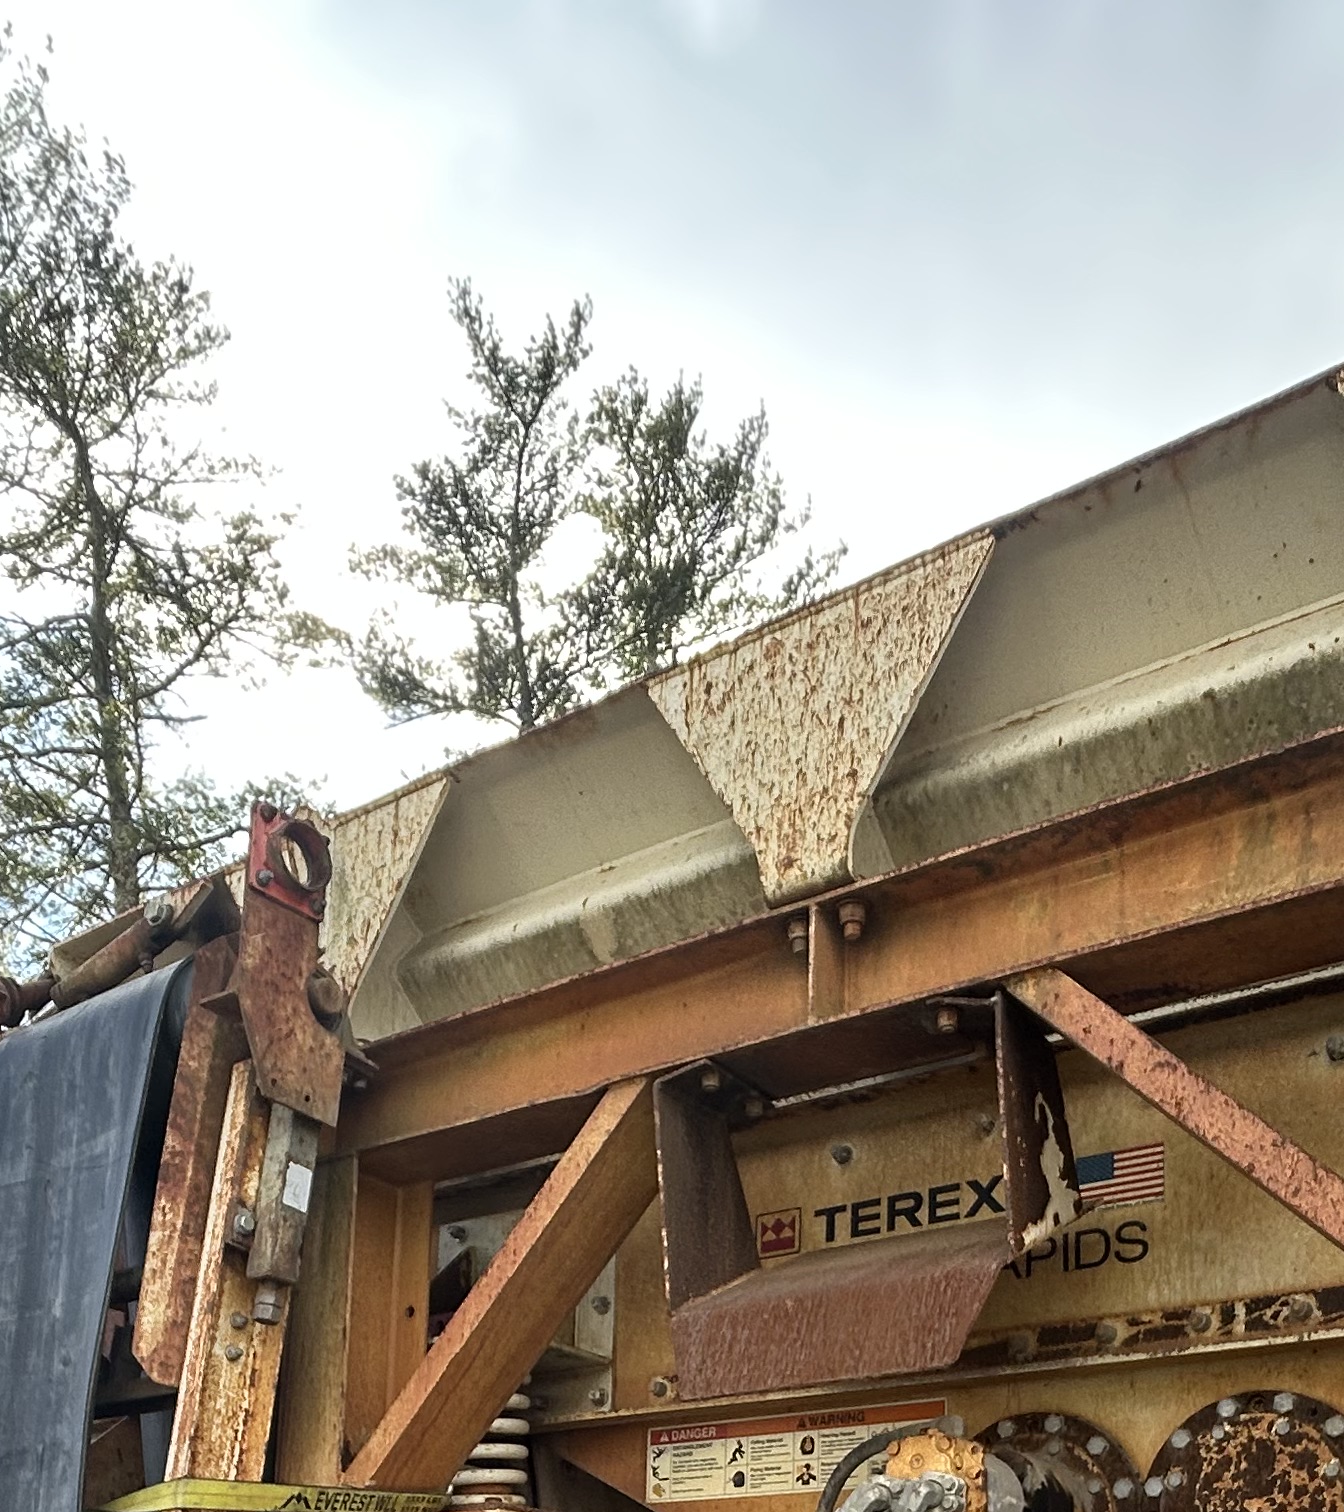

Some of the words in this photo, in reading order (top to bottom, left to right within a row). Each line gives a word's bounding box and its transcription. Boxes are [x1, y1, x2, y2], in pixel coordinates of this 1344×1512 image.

[813, 1174, 1005, 1243] TEREX
[808, 1411, 866, 1427] WARNING
[671, 1426, 717, 1443] DANGER
[314, 1490, 375, 1511] EVEREST
